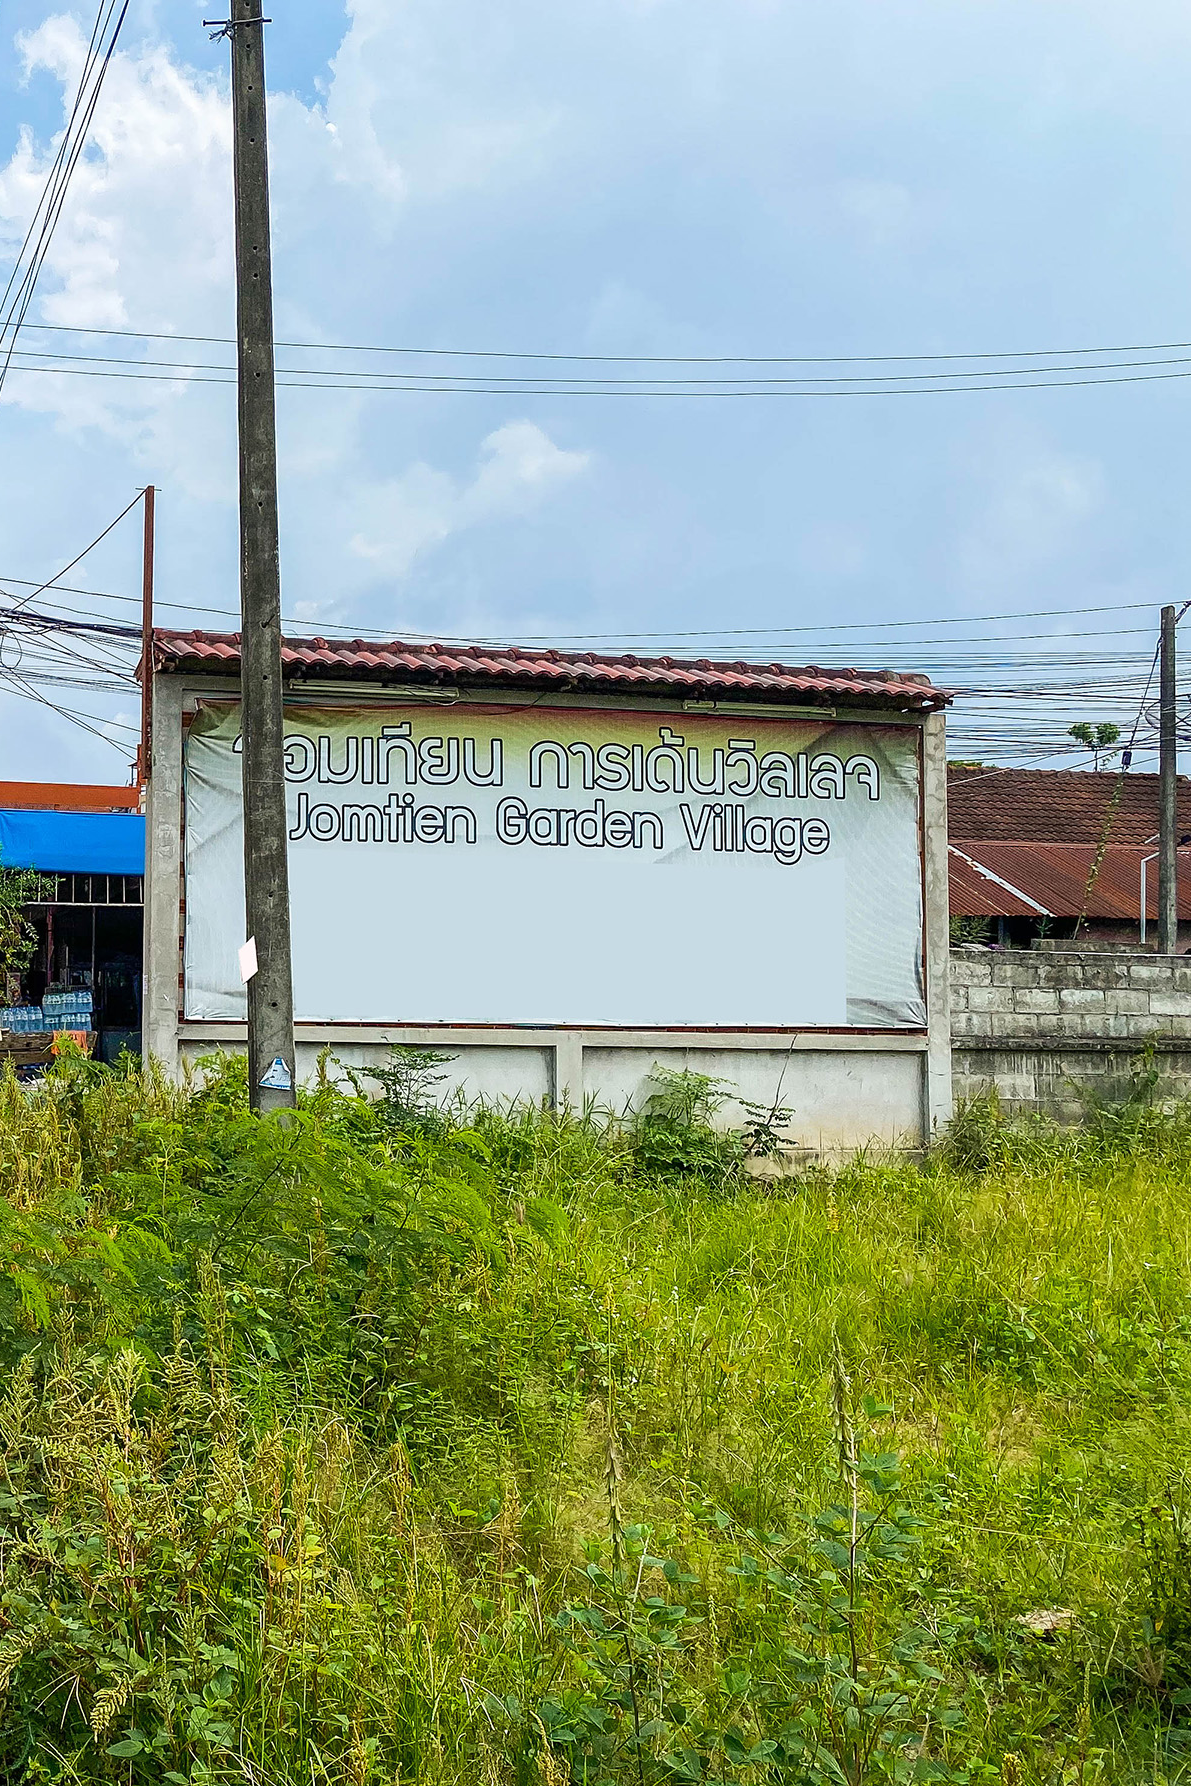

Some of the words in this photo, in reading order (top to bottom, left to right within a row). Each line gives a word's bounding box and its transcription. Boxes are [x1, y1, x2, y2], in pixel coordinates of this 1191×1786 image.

[232, 722, 504, 786] อมเทียน
[289, 793, 477, 844] Jomtien
[496, 796, 664, 850] Garden
[679, 803, 831, 866] Village
